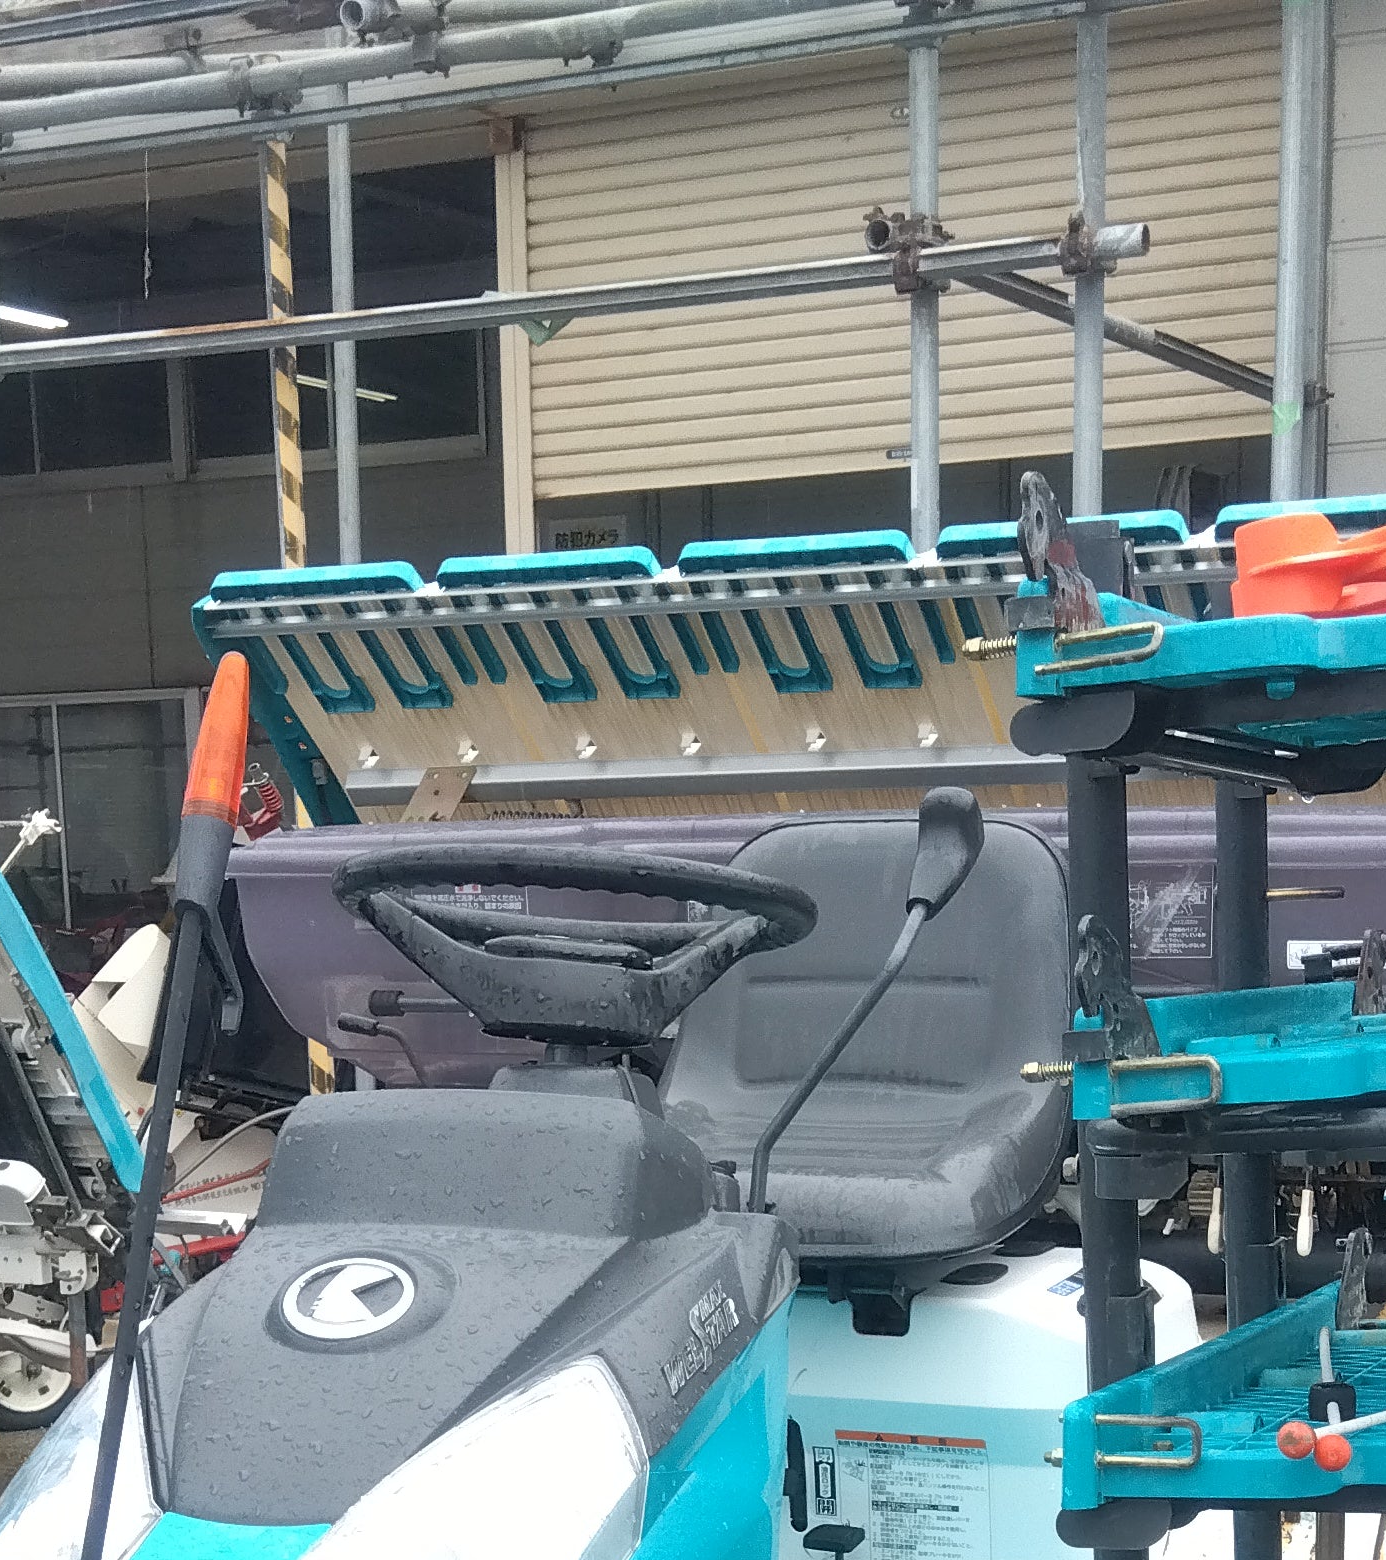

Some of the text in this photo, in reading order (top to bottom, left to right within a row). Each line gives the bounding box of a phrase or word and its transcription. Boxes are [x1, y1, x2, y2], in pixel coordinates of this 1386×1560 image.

[555, 527, 619, 550] 防犯カメラ
